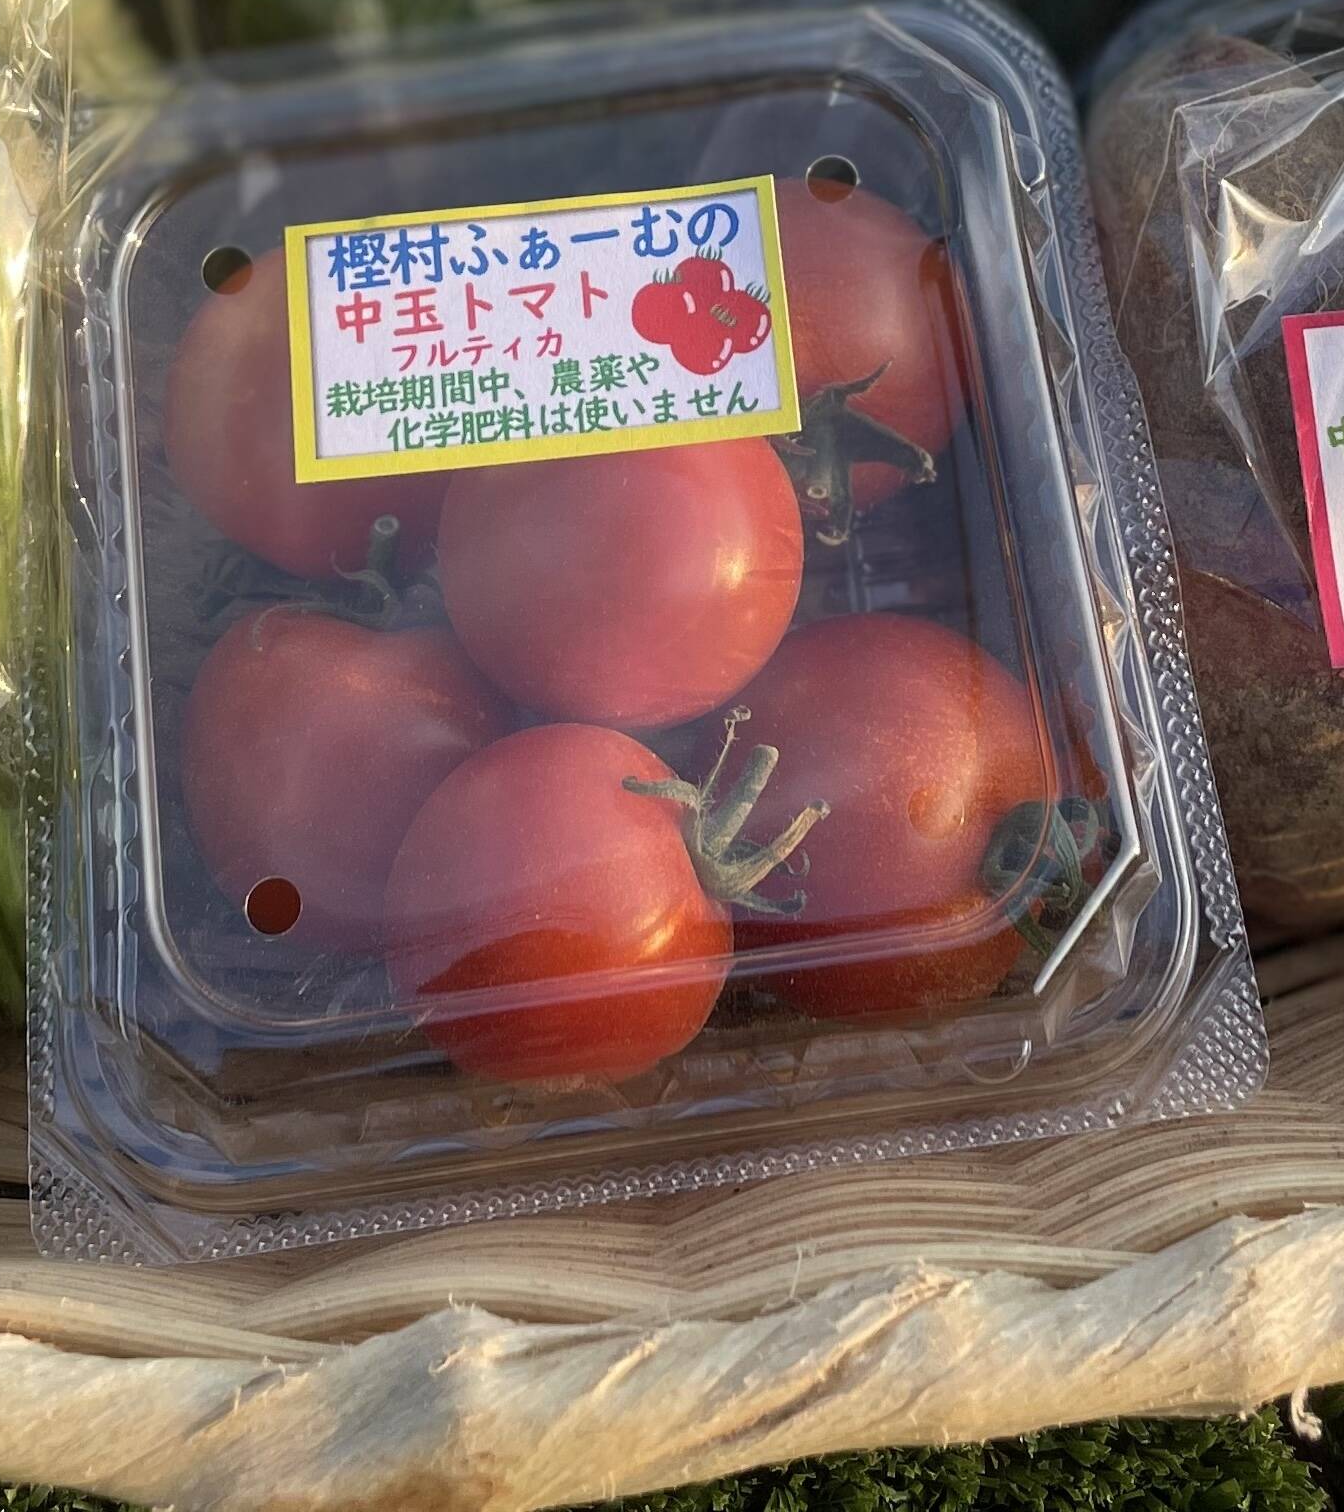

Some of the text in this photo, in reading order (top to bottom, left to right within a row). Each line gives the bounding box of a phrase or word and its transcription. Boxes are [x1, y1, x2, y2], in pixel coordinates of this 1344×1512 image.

[327, 203, 739, 291] 樫村ふぁーむの
[335, 270, 609, 343] 中玉トマト
[326, 352, 660, 419] 栽培期間中、農薬や
[392, 327, 563, 372] フルティカ
[387, 380, 759, 452] 化学肥料は使いません
